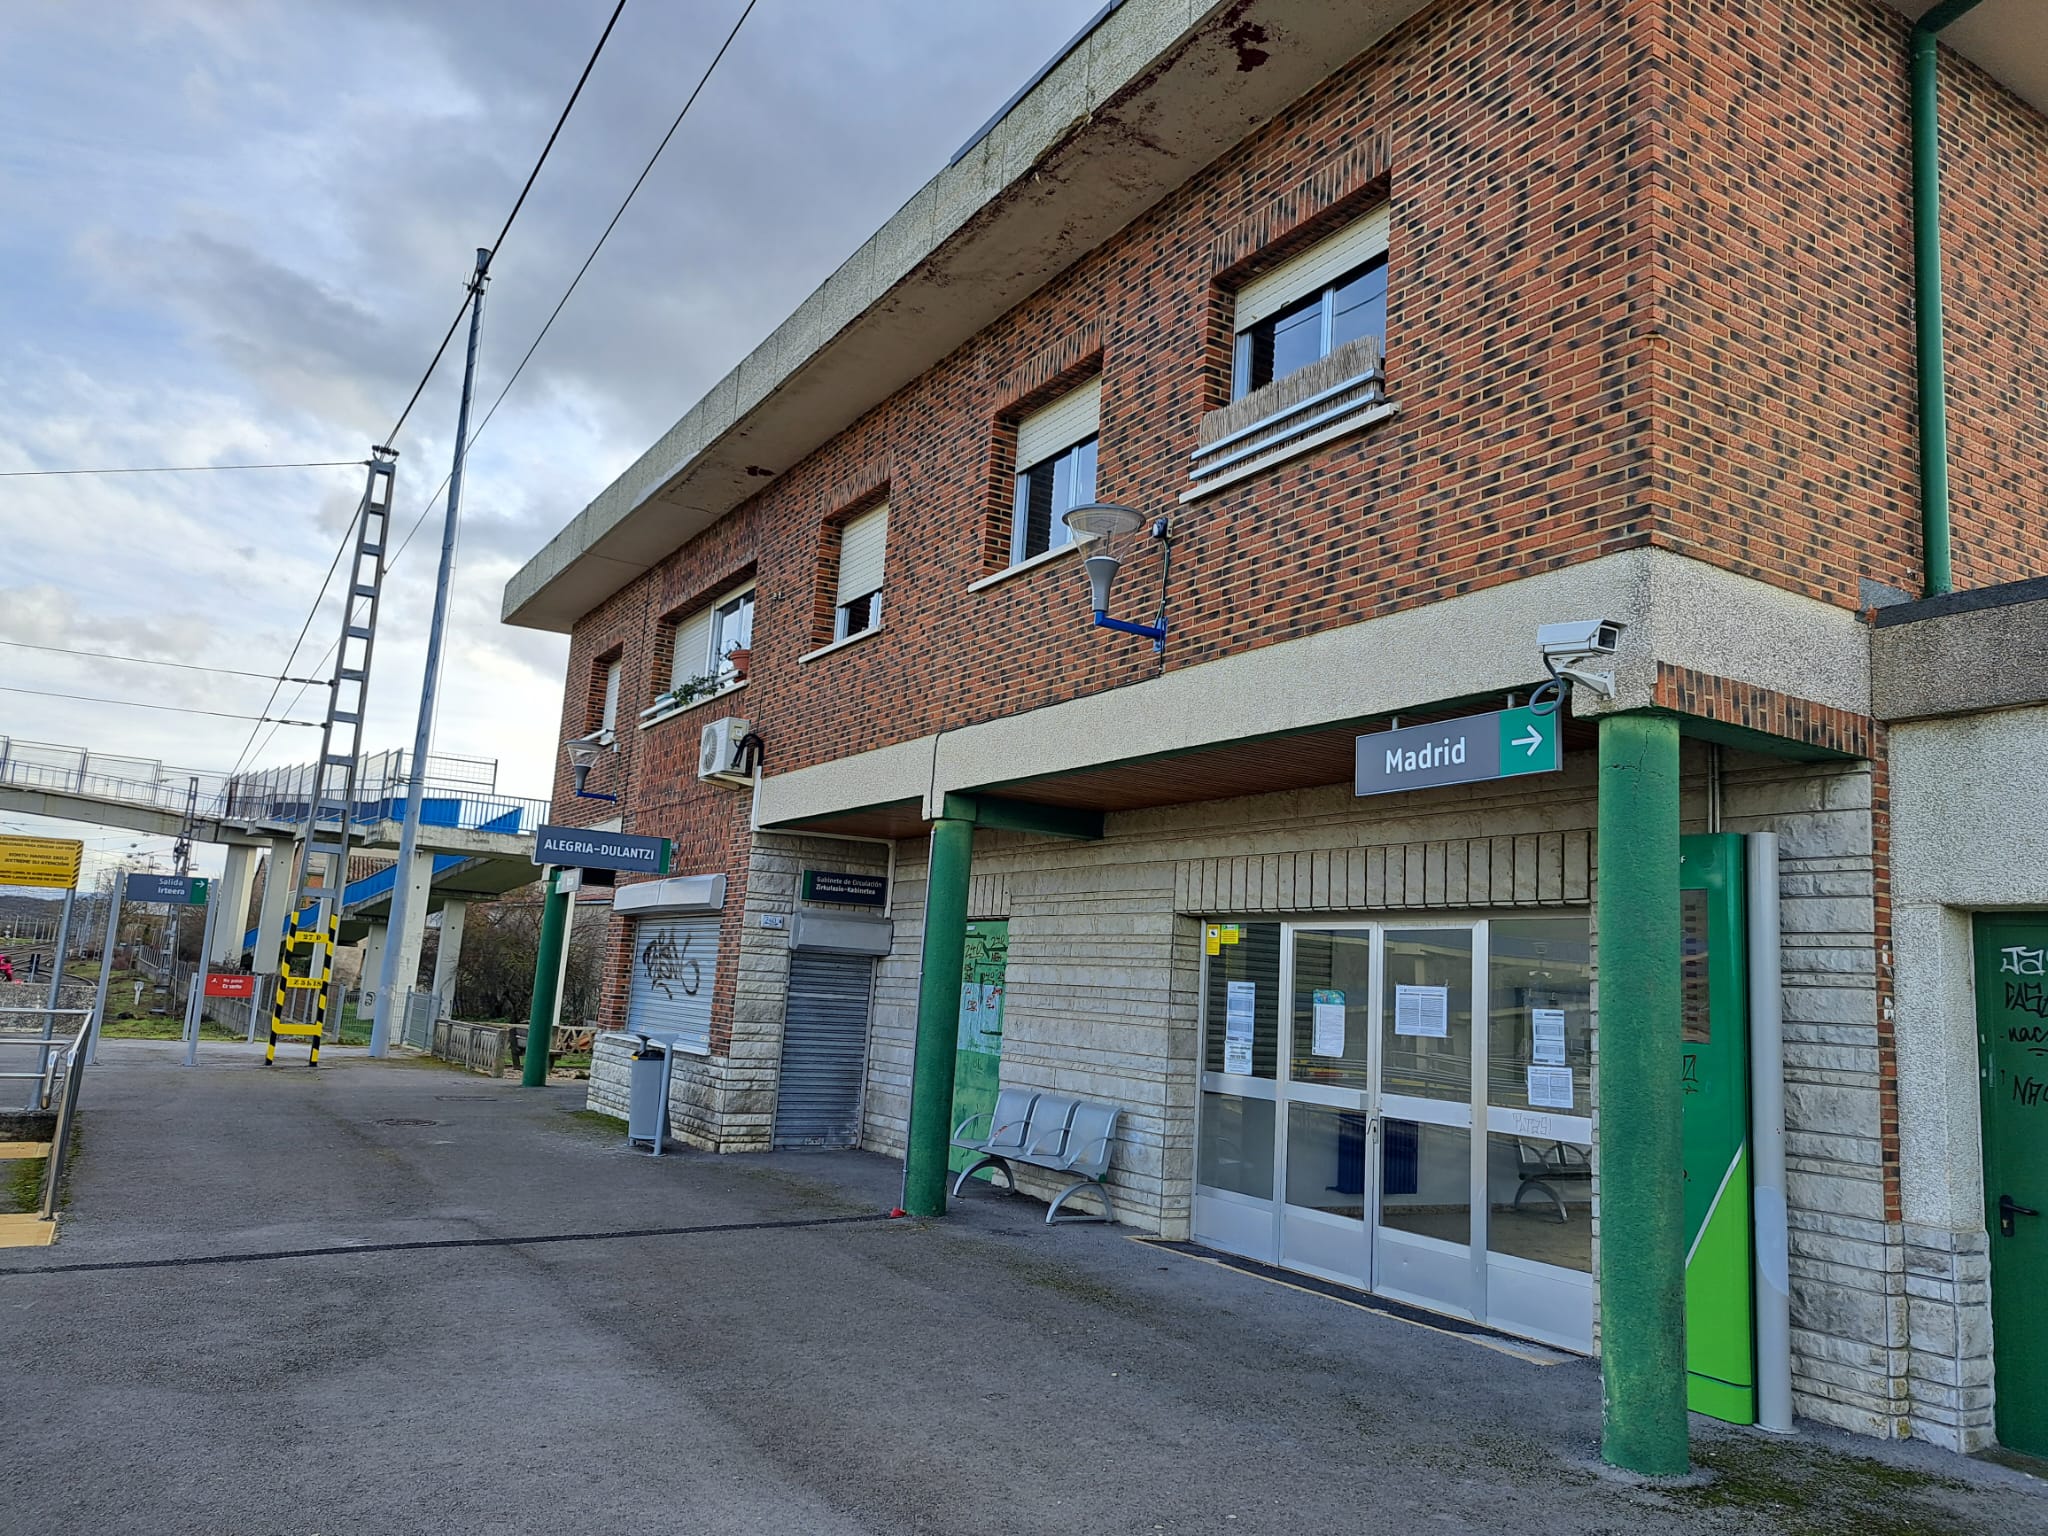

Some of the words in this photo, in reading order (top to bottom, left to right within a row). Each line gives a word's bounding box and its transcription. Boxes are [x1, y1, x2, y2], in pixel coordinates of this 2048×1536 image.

[1385, 736, 1466, 774] Madrid
[544, 838, 655, 860] ALEGRIA-DULANTZI
[158, 878, 184, 886] Salida
[816, 875, 842, 884] Gabinete
[158, 887, 185, 895] Irteera
